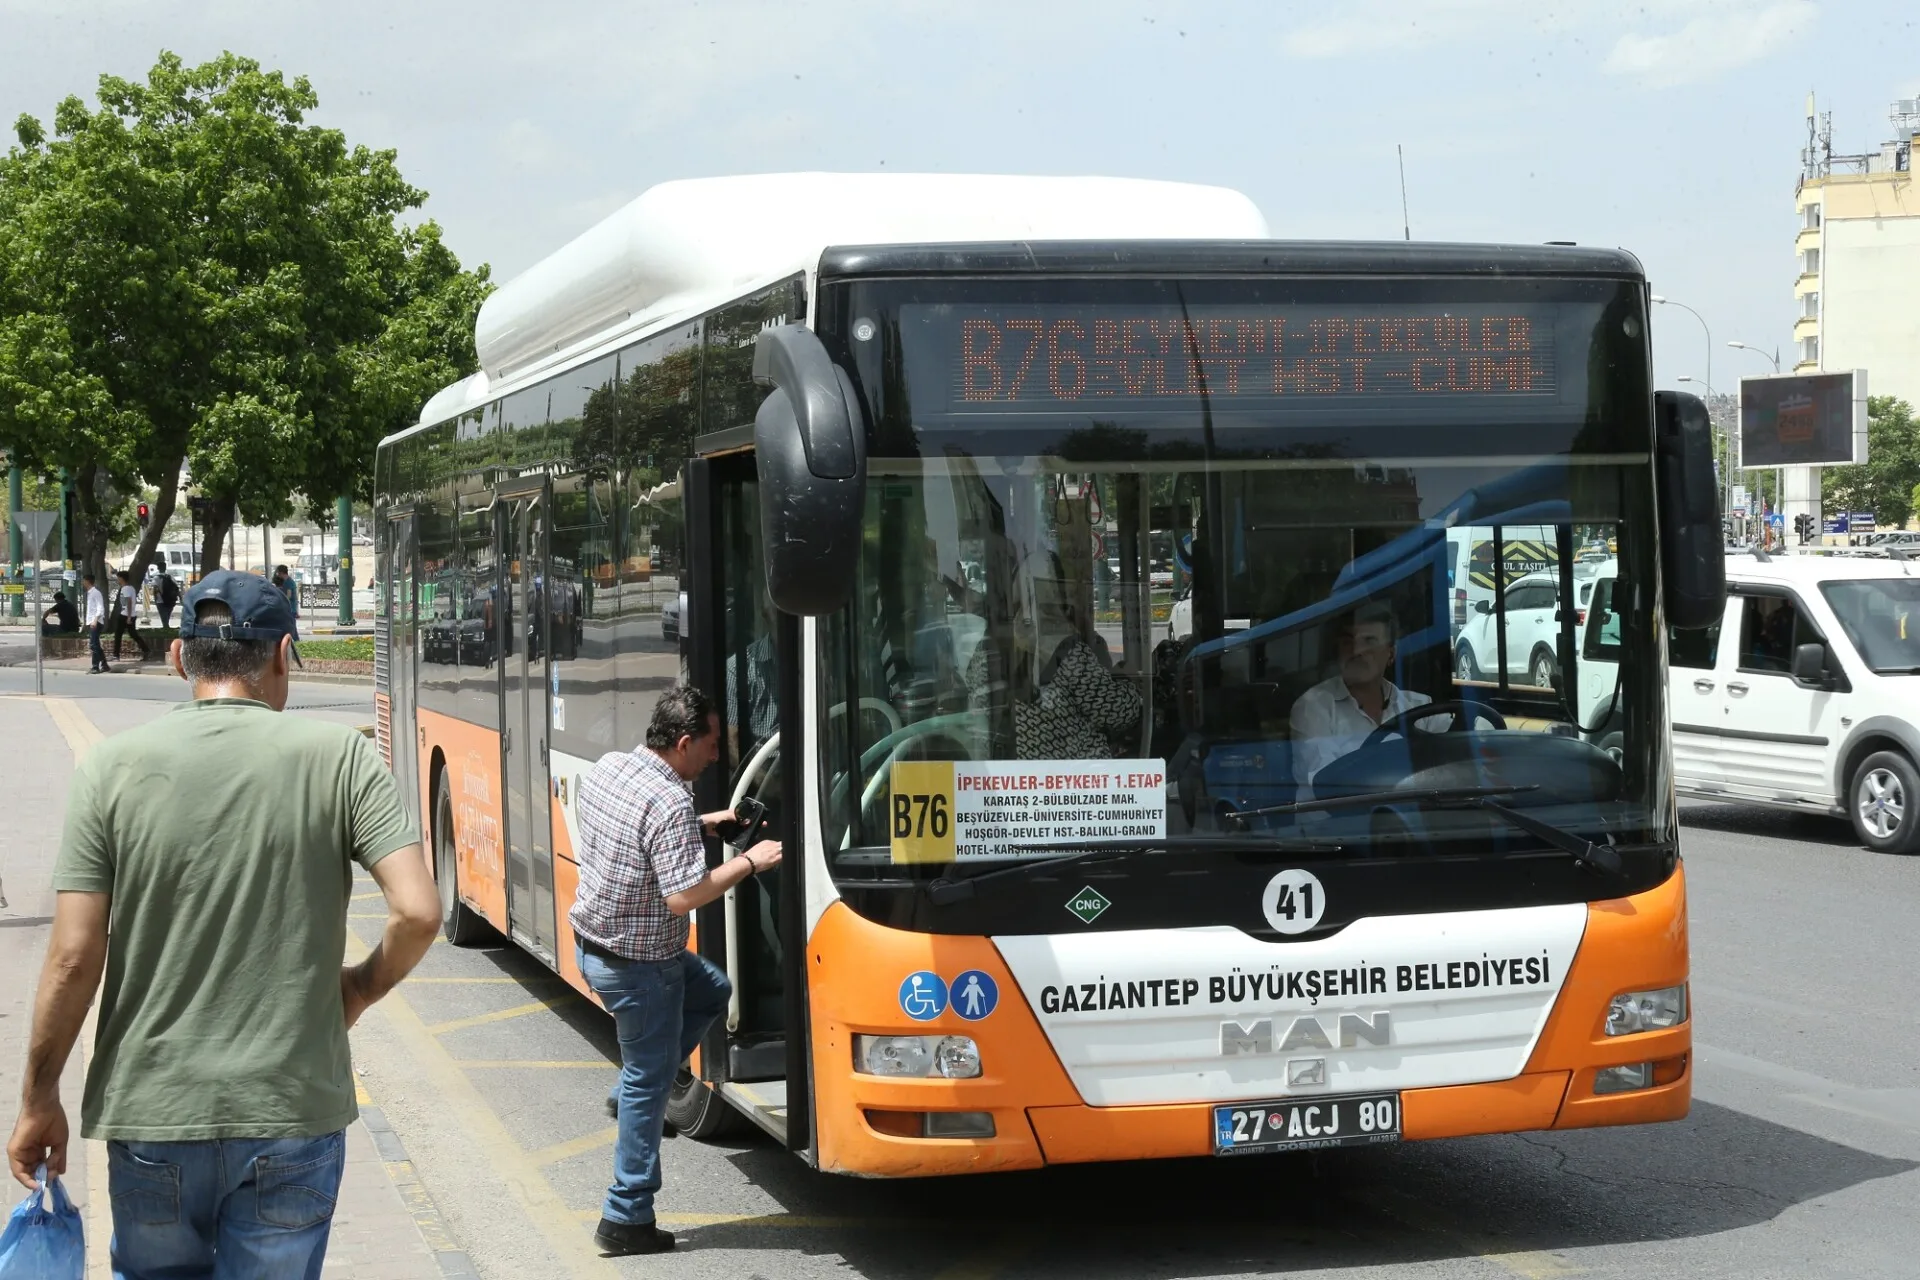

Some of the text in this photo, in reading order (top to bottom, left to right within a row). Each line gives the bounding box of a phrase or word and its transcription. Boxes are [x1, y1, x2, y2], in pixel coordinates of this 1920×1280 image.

[761, 313, 786, 330] MAN
[963, 319, 1086, 400] B76
[957, 772, 1163, 792] İPEKEVLER-BEYKENT 1.ETAP
[983, 793, 1138, 808] KARATAŞ 2-BÜLBÜLZADE MAH.
[893, 793, 949, 839] B76
[956, 808, 1164, 824] BEŞYÜZEVLER-ÜNİVERSİTE-CUMHURİYET
[965, 825, 1157, 841] HOŞGÖR-DEVLET HST.-BALIKLI-GRAND
[1075, 899, 1101, 911] CNG
[1275, 883, 1314, 920] 41
[1040, 949, 1550, 1014] GAZİANTEP BÜYÜKŞEHİR BELEDİYESİ
[1219, 1011, 1391, 1056] MAN
[1220, 1100, 1393, 1142] TR 27 ACJ 80
